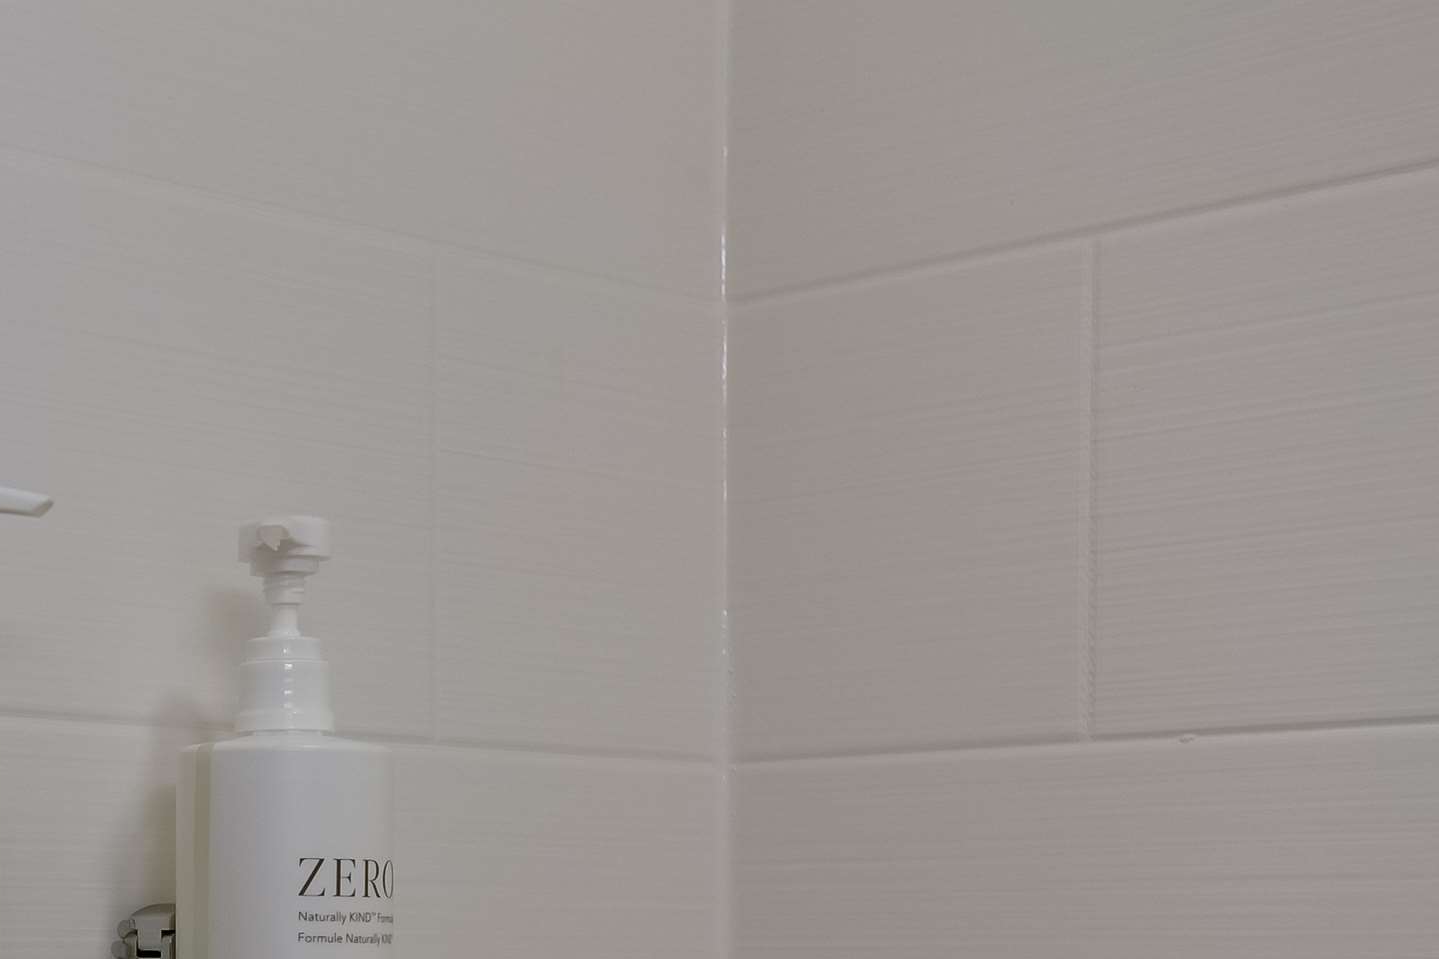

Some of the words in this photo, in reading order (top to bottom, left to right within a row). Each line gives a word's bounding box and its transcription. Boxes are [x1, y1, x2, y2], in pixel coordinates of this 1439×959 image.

[298, 857, 394, 899] ZERO
[298, 910, 347, 926] Naturally
[298, 932, 343, 944] Formule
[346, 933, 380, 948] Naturally
